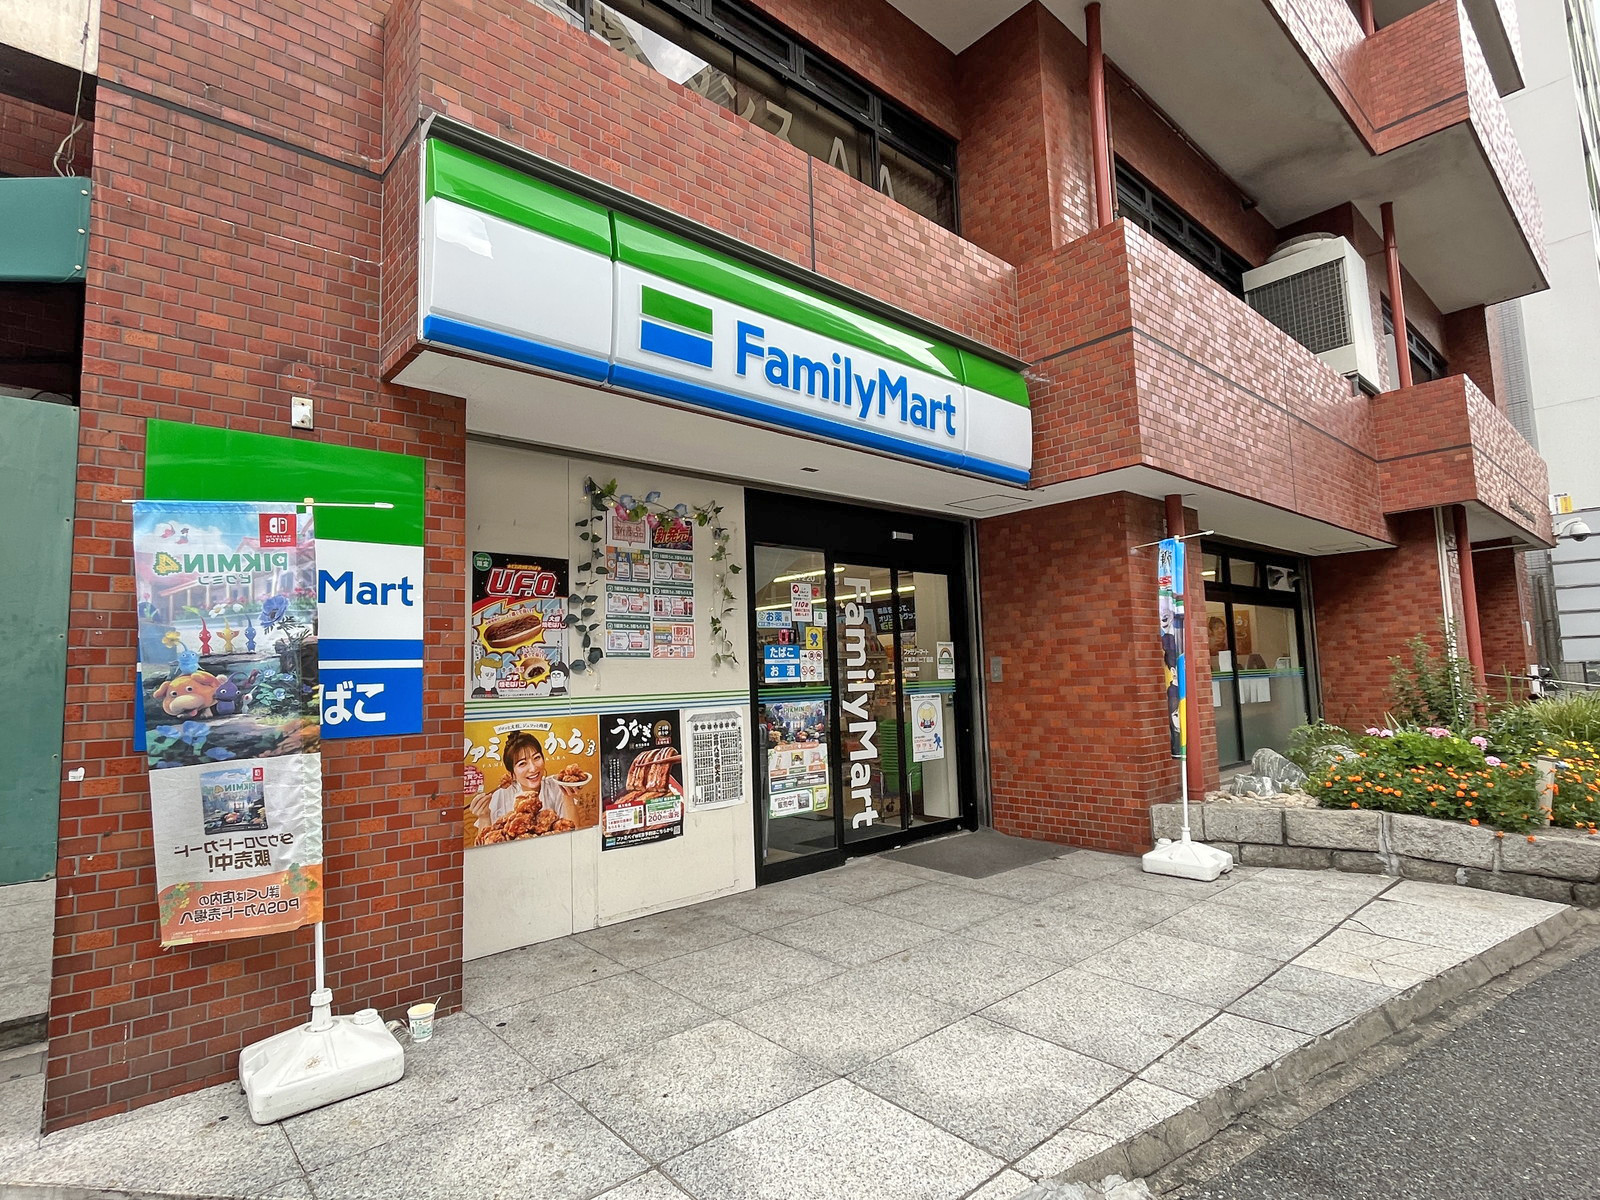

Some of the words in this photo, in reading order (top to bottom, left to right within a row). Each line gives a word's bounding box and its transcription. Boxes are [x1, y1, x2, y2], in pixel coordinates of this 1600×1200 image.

[735, 319, 957, 437] FamilyMart
[766, 611, 783, 623] お薬
[769, 646, 795, 658] たばこ
[842, 577, 879, 829] FamilyMart
[610, 717, 652, 750] うなぎ
